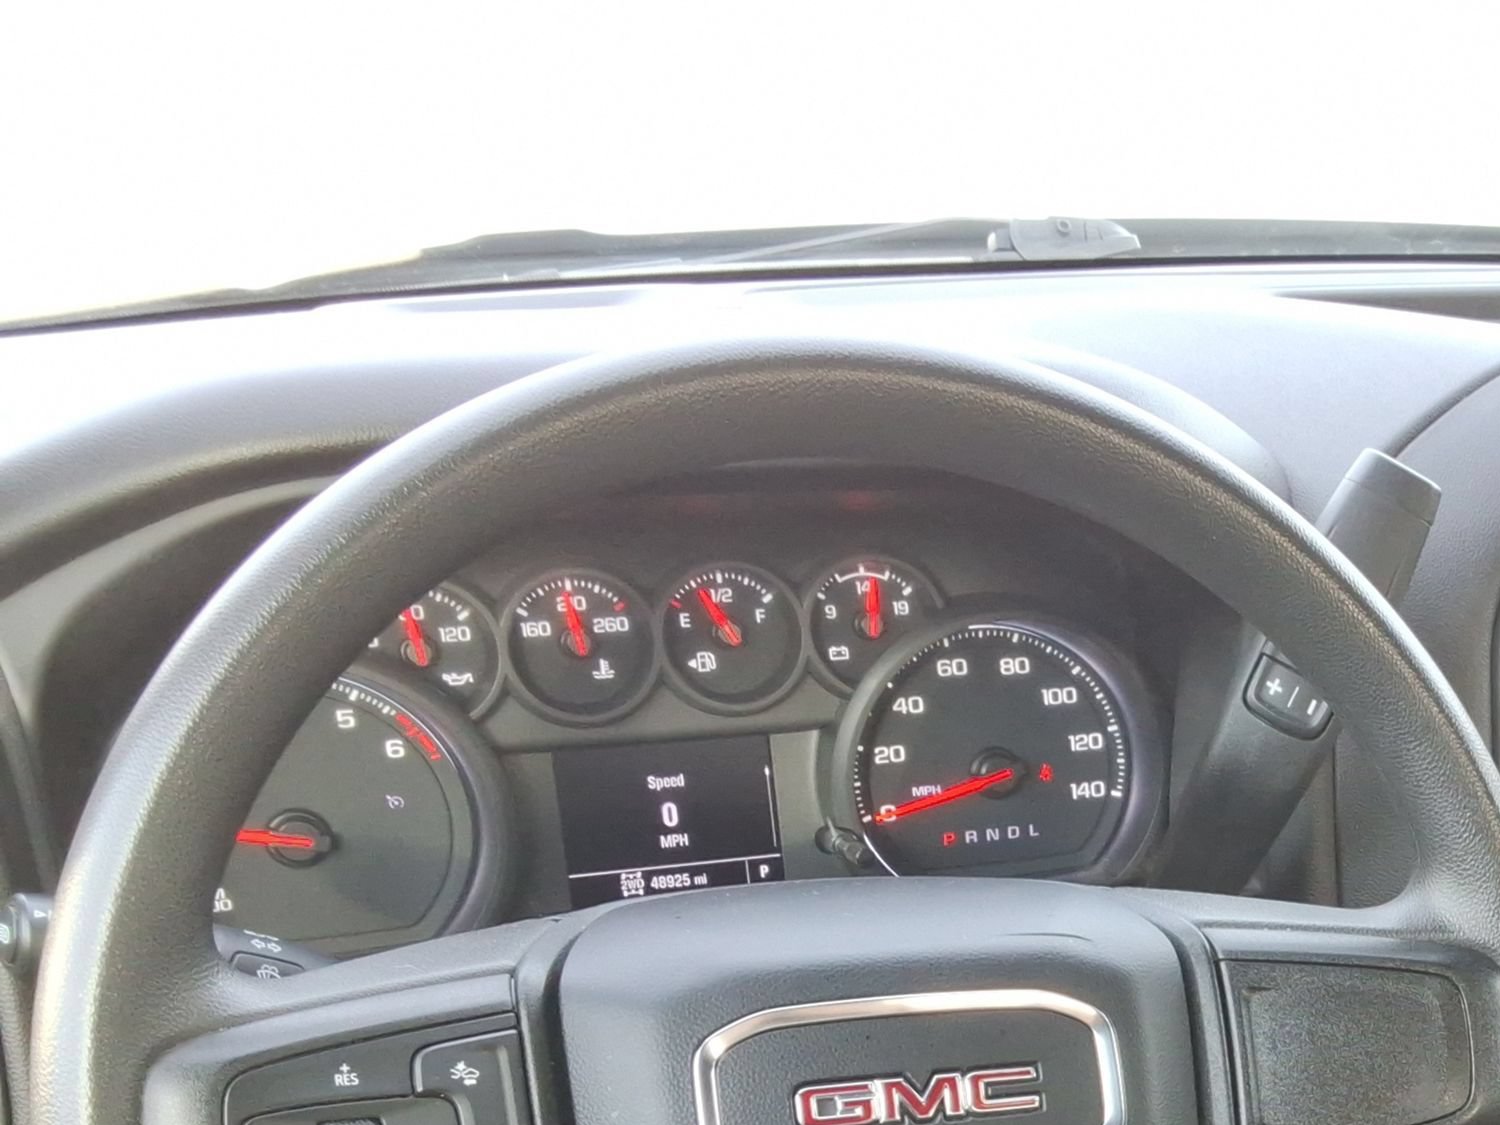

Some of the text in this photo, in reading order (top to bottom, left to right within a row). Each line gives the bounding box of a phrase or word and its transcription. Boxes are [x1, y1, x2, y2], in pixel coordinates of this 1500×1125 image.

[711, 587, 732, 602] 1/2
[556, 596, 587, 612] 20
[824, 604, 836, 619] 9
[892, 600, 909, 615] 19
[679, 613, 691, 628] E
[755, 608, 766, 623] F
[520, 621, 552, 638] 160
[593, 617, 629, 633] 260
[438, 625, 471, 643] 120
[936, 658, 968, 677] 60
[999, 656, 1030, 675] 80
[1041, 686, 1078, 706] 100
[892, 696, 924, 715] 40
[335, 708, 356, 729] 5
[385, 739, 405, 759] 6
[1068, 732, 1104, 752] 120
[873, 744, 906, 764] 20
[647, 772, 685, 791] Speed
[1069, 780, 1106, 800] 140
[911, 785, 942, 798] MPH
[661, 801, 679, 827] 0
[659, 832, 689, 849] MPH
[964, 830, 978, 844] R
[985, 828, 1000, 842] N
[1007, 825, 1020, 839] D
[1028, 823, 1040, 837] L
[759, 864, 769, 879] P
[650, 875, 691, 889] 48925
[334, 1073, 359, 1087] RES
